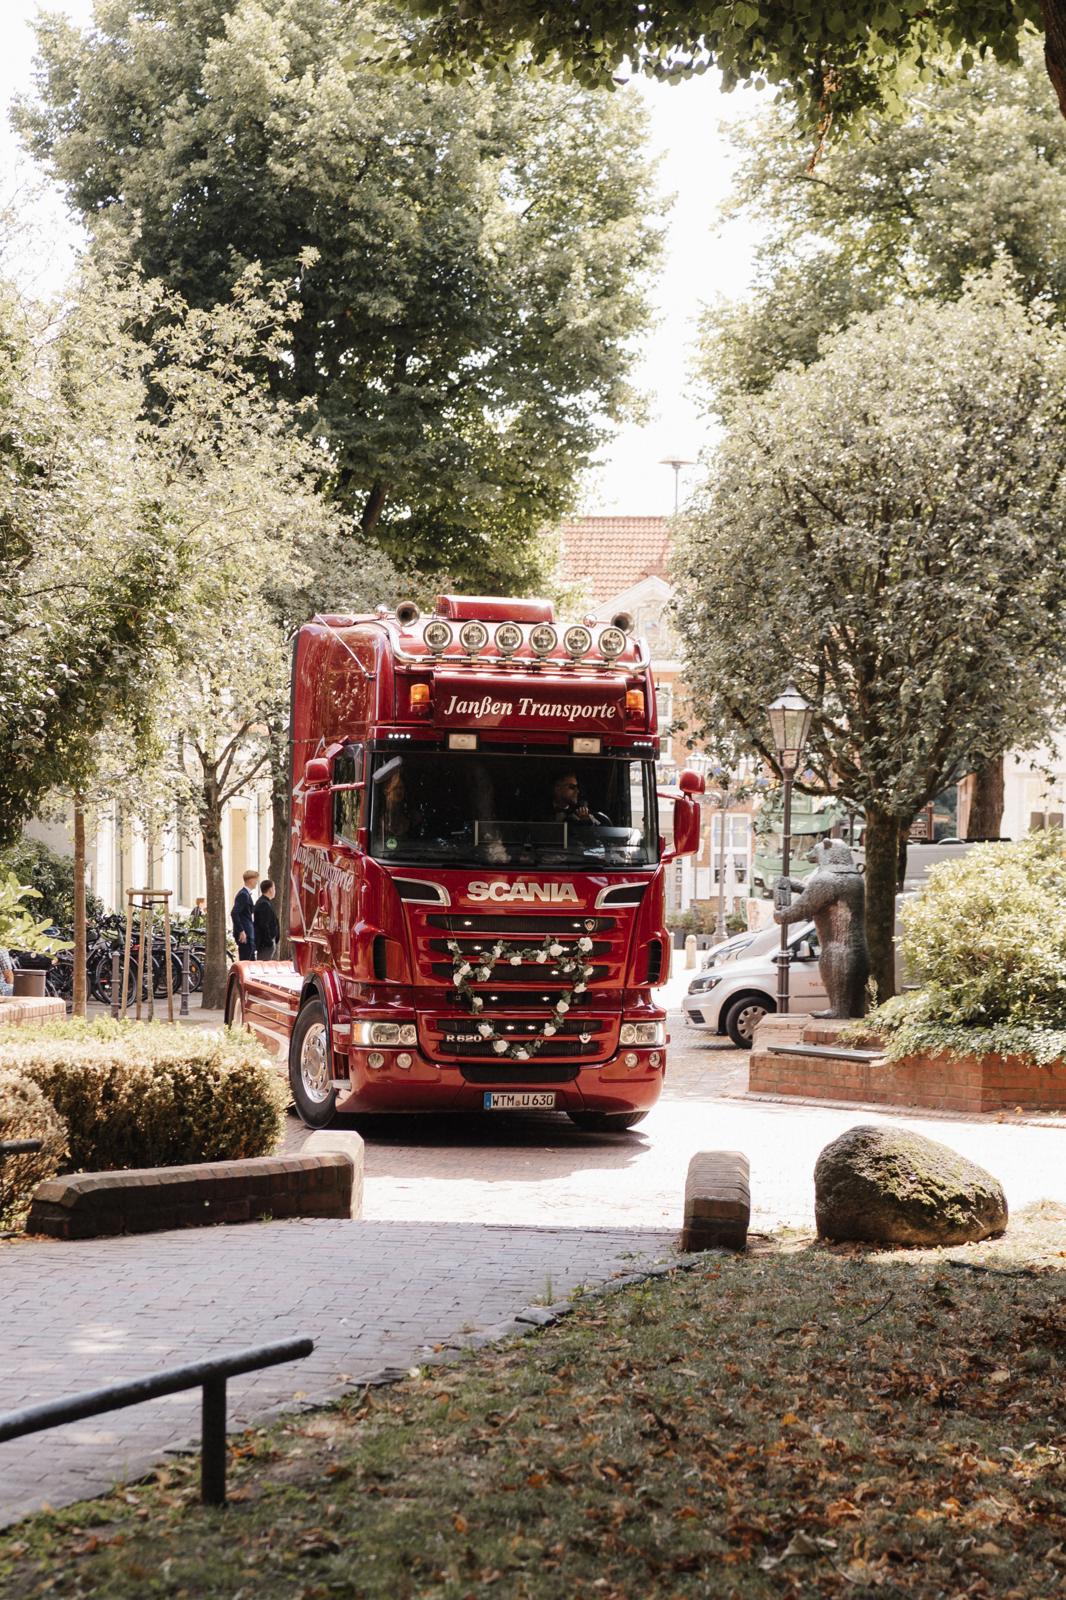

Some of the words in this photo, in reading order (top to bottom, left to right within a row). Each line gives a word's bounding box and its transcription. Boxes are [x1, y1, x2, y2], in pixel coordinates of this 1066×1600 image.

[444, 695, 513, 719] Janßen
[518, 698, 617, 722] Transporte
[466, 881, 579, 903] SCANIA
[446, 1034, 455, 1043] R
[456, 1034, 482, 1043] 620
[492, 1095, 515, 1107] WTM
[522, 1095, 530, 1106] U
[531, 1095, 554, 1106] 630
